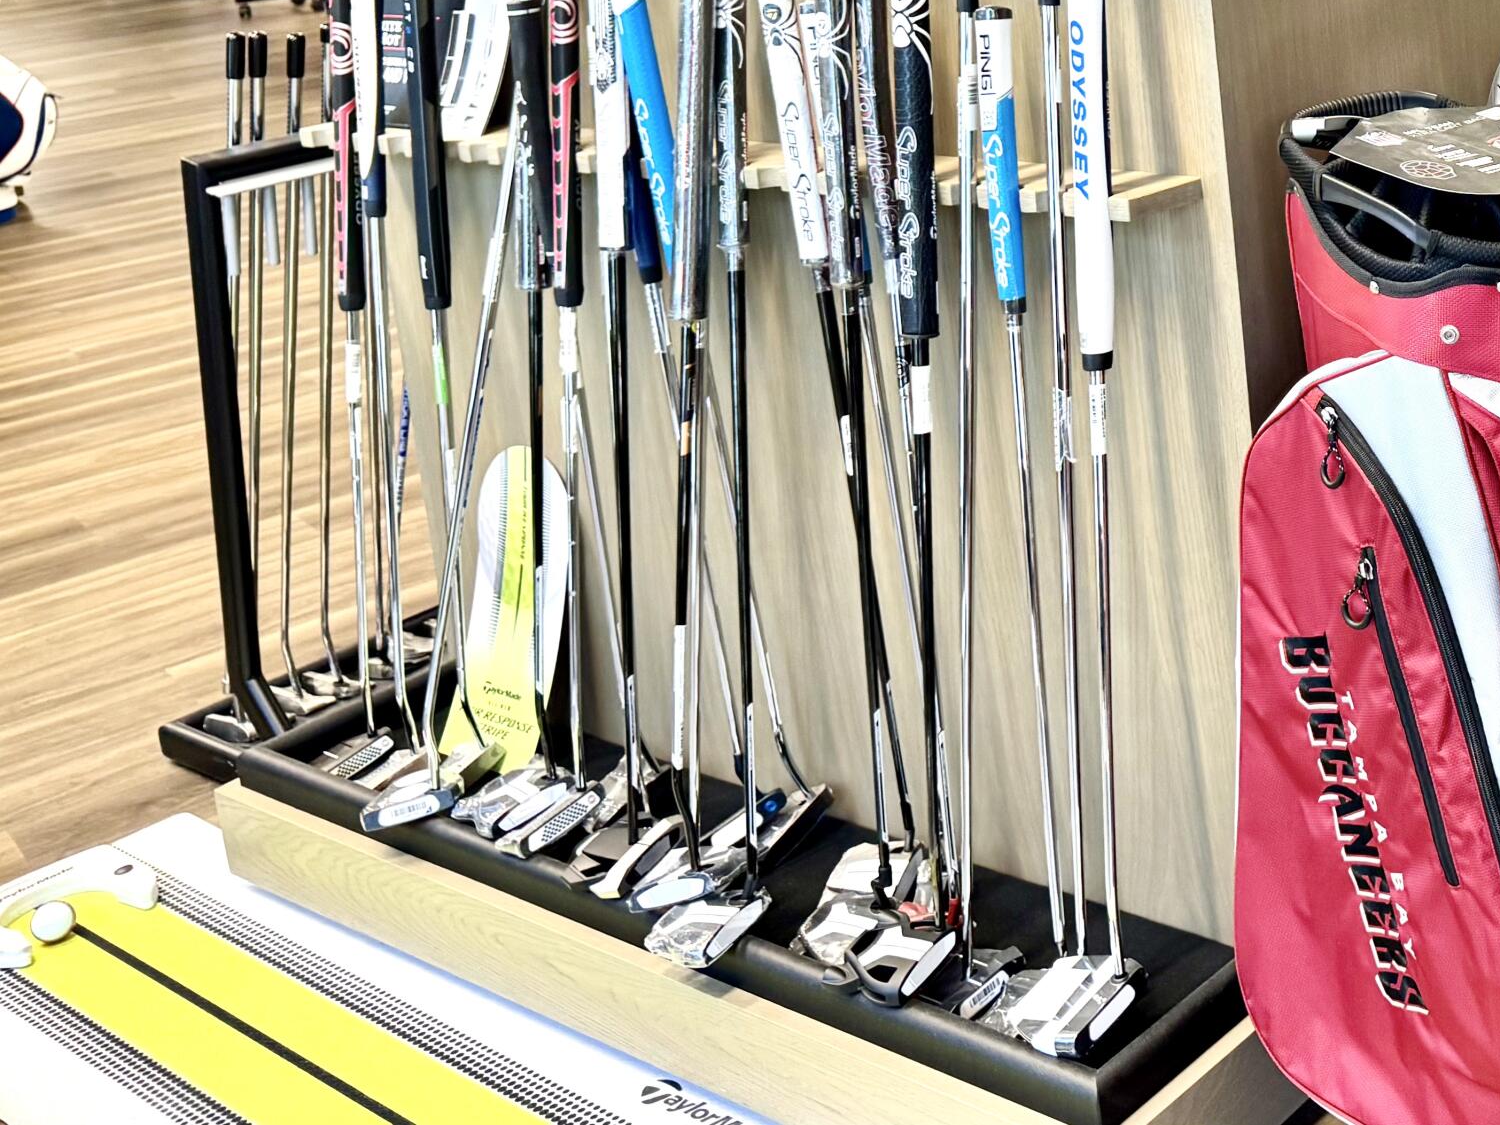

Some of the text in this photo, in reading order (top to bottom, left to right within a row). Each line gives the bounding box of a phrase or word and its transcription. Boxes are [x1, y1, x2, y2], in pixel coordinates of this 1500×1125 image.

[979, 34, 993, 91] PING
[1070, 20, 1090, 201] ODYSSEY
[634, 97, 672, 247] Super Stroke
[780, 101, 815, 242] Super Stroke
[895, 125, 920, 299] Super Stroke
[982, 132, 1012, 289] Super Stroke
[484, 711, 534, 734] RESPONSE
[1278, 632, 1429, 1016] BUCCANEERS
[1341, 690, 1417, 960] TAMPA BAY
